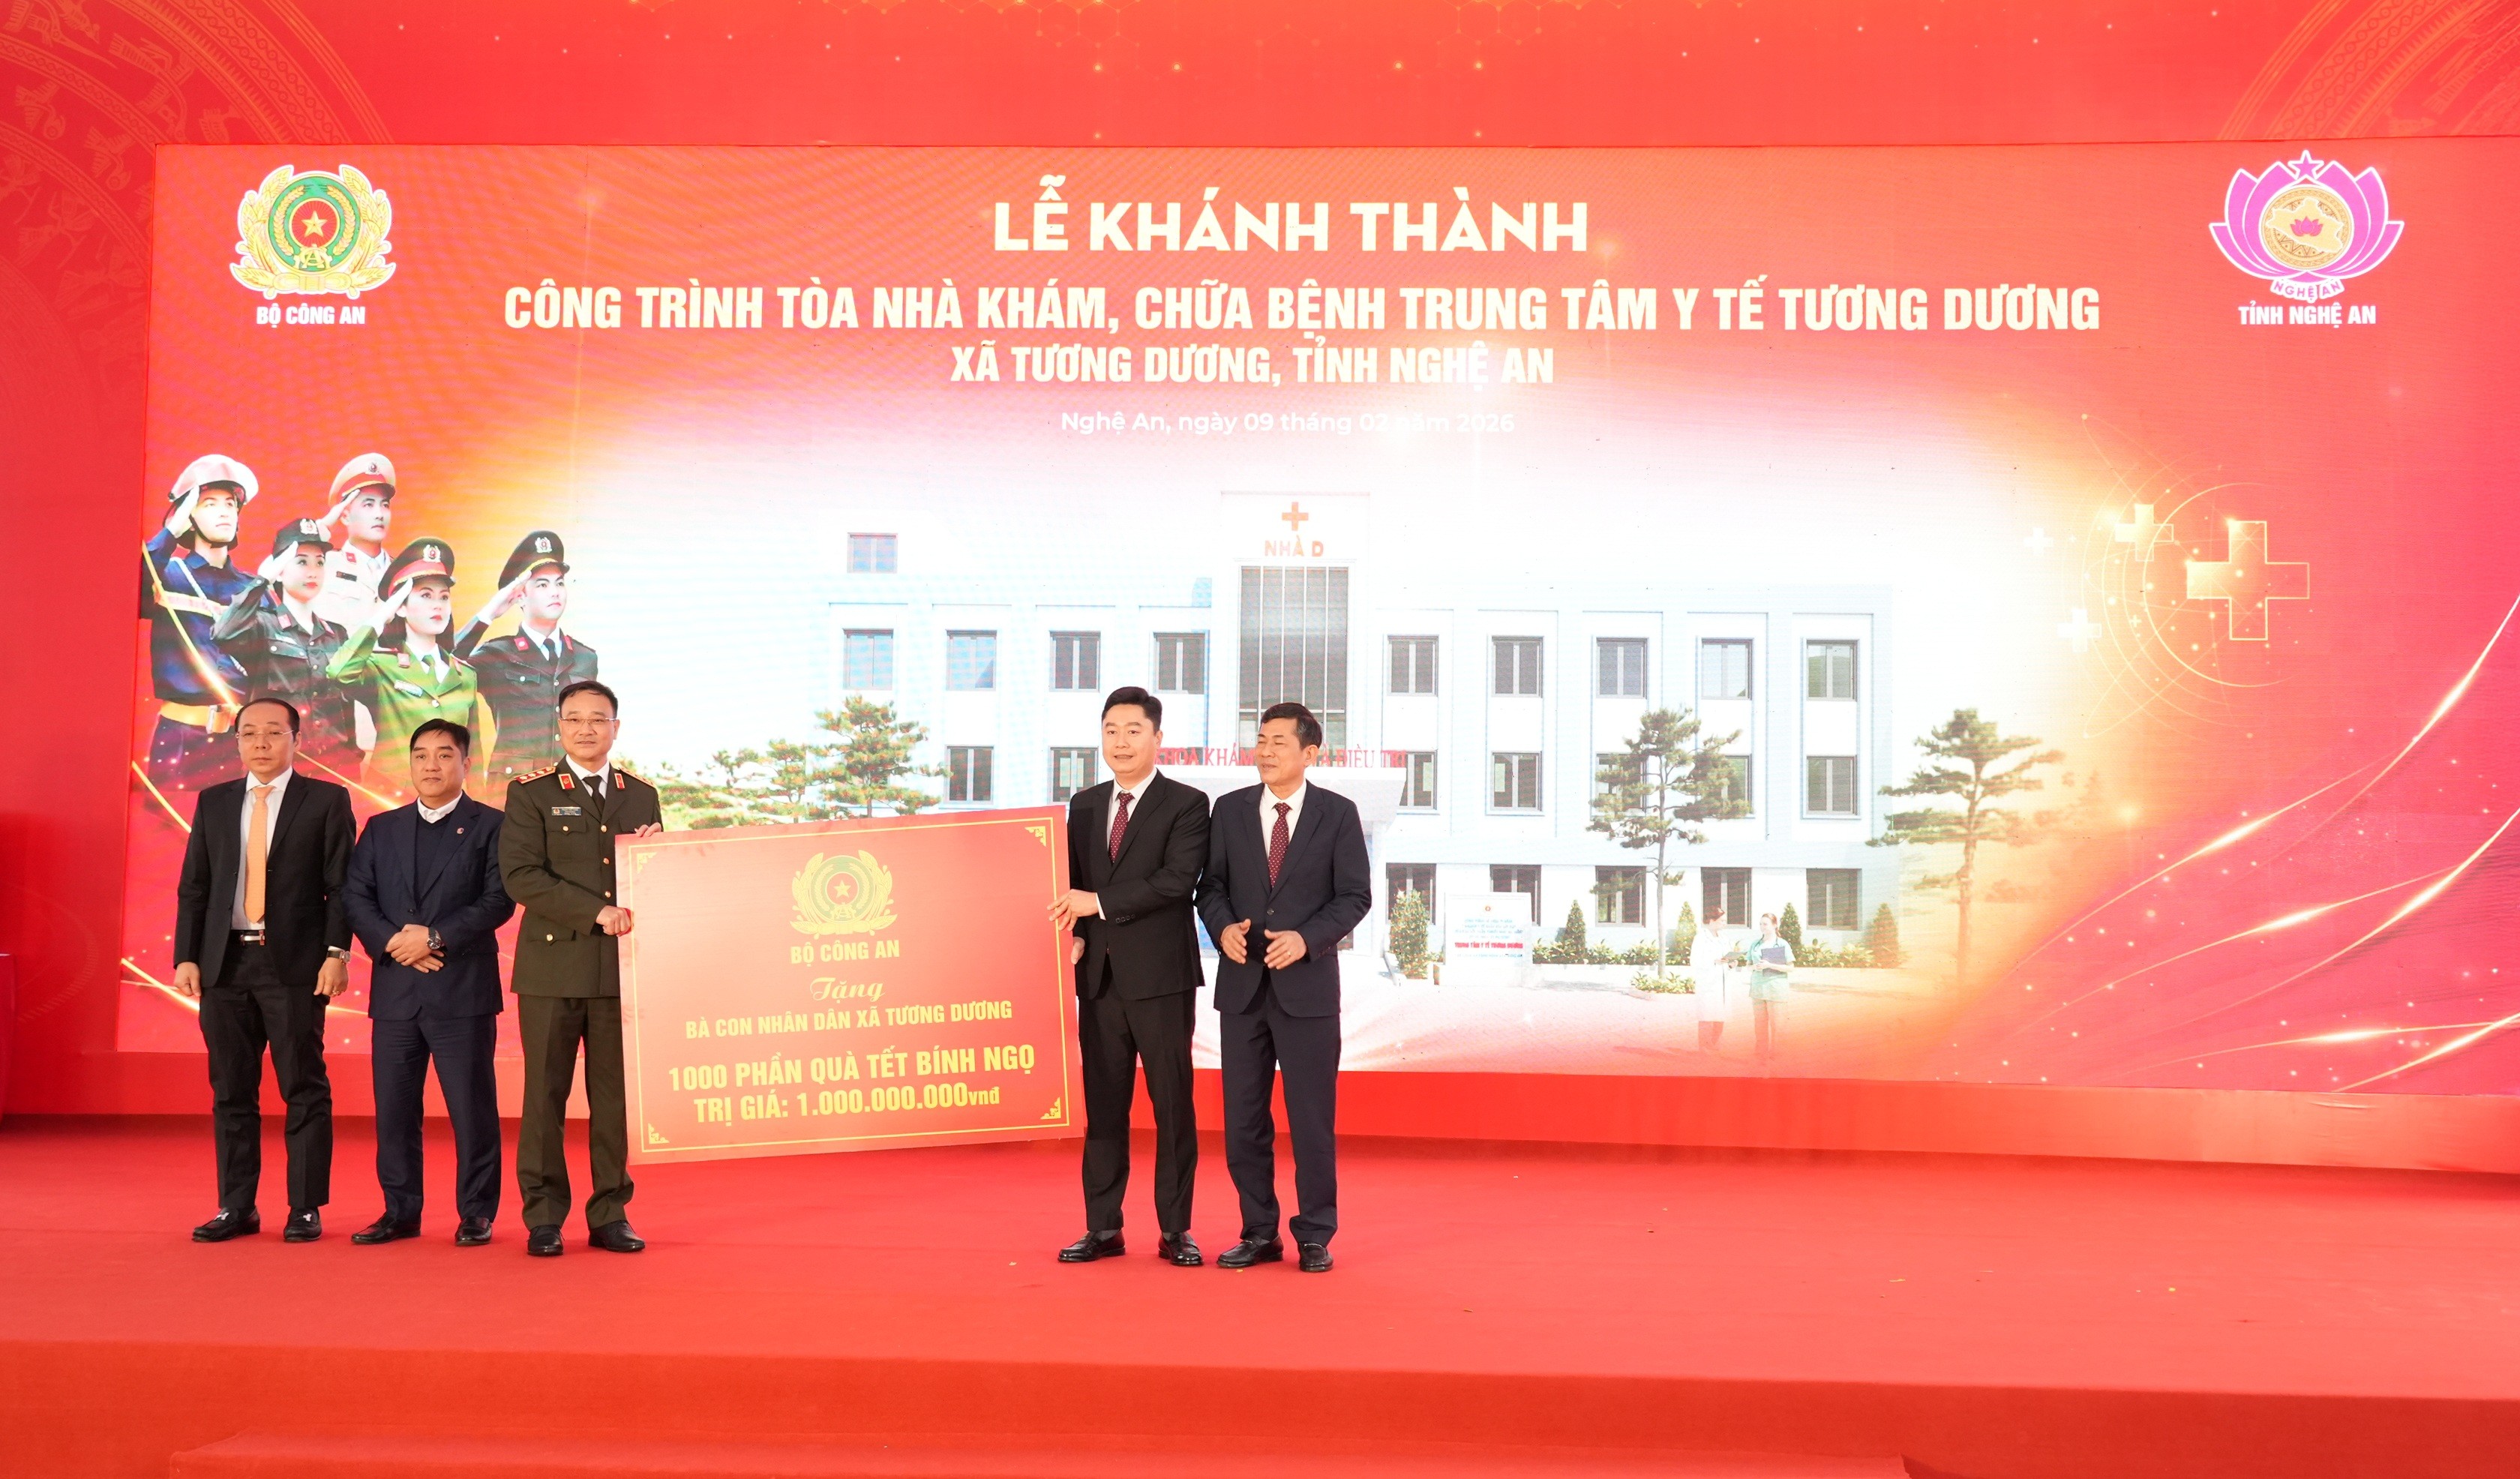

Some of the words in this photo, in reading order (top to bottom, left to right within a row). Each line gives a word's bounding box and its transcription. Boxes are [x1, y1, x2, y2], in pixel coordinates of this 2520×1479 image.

[995, 175, 1068, 250] LỄ
[1090, 188, 1328, 251] KHÁNH
[1350, 188, 1587, 252] THÀNH
[2274, 281, 2314, 301] NGHỆ
[2322, 281, 2341, 297] AN
[256, 303, 280, 328] BỘ
[286, 303, 334, 324] CÔNG
[340, 307, 365, 324] AN
[506, 279, 621, 328] CÔNG
[636, 279, 763, 328] TRÌNH
[777, 277, 858, 328] TÒA
[873, 278, 963, 328] NHÀ
[978, 278, 1118, 334] KHÁM,
[1136, 279, 1252, 329] CHỮA
[1268, 279, 1384, 340] BỆNH
[1400, 288, 1546, 330] TRUNG
[1562, 280, 1656, 329] TÂM
[1672, 289, 1699, 329] Y
[1713, 274, 1767, 329] TẾ
[1778, 284, 1928, 331] TƯƠNG
[1944, 284, 2098, 330] DƯƠNG
[2239, 300, 2283, 324] TỈNH
[2290, 302, 2342, 328] NGHỆ
[2348, 306, 2375, 324] AN
[950, 340, 1000, 382] XÃ
[1012, 344, 1131, 382] TƯƠNG
[1144, 344, 1280, 387] DƯƠNG,
[1293, 334, 1378, 383] TỈNH
[1389, 340, 1489, 392] NGHỆ
[1502, 345, 1554, 384] AN
[1061, 410, 1125, 435] Nghệ
[1132, 412, 1171, 434] An,
[1179, 412, 1237, 435] ngày
[1244, 412, 1274, 431] 09
[1280, 411, 1351, 435] tháng
[1359, 412, 1388, 432] 02
[1395, 412, 1449, 432] năm
[1456, 412, 1515, 432] 2026
[1265, 535, 1304, 557] NHÀ
[1312, 541, 1324, 557] D
[1155, 748, 1199, 765] KHOA
[788, 940, 816, 968] BỘ
[819, 939, 871, 963] CÔNG
[873, 938, 902, 960] AN
[808, 976, 886, 1005] Tặng
[686, 1016, 711, 1040] BÀ
[715, 1016, 753, 1038] CON
[758, 1010, 808, 1034] NHÂN
[814, 1008, 851, 1030] DÂN
[856, 1005, 881, 1029] XÃ
[885, 1004, 945, 1026] TƯƠNG
[950, 1000, 1013, 1022] DƯƠNG
[668, 1064, 728, 1091] 1000
[735, 1052, 802, 1087] PHẦN
[810, 1050, 860, 1084] QUÀ
[866, 1045, 908, 1078] TẾT
[916, 1045, 976, 1076] BÍNH
[983, 1044, 1035, 1075] NGỌ
[693, 1096, 732, 1127] TRỊ
[740, 1088, 788, 1120] GIÁ:
[796, 1082, 1000, 1117] 1.000.000.000vnđ
